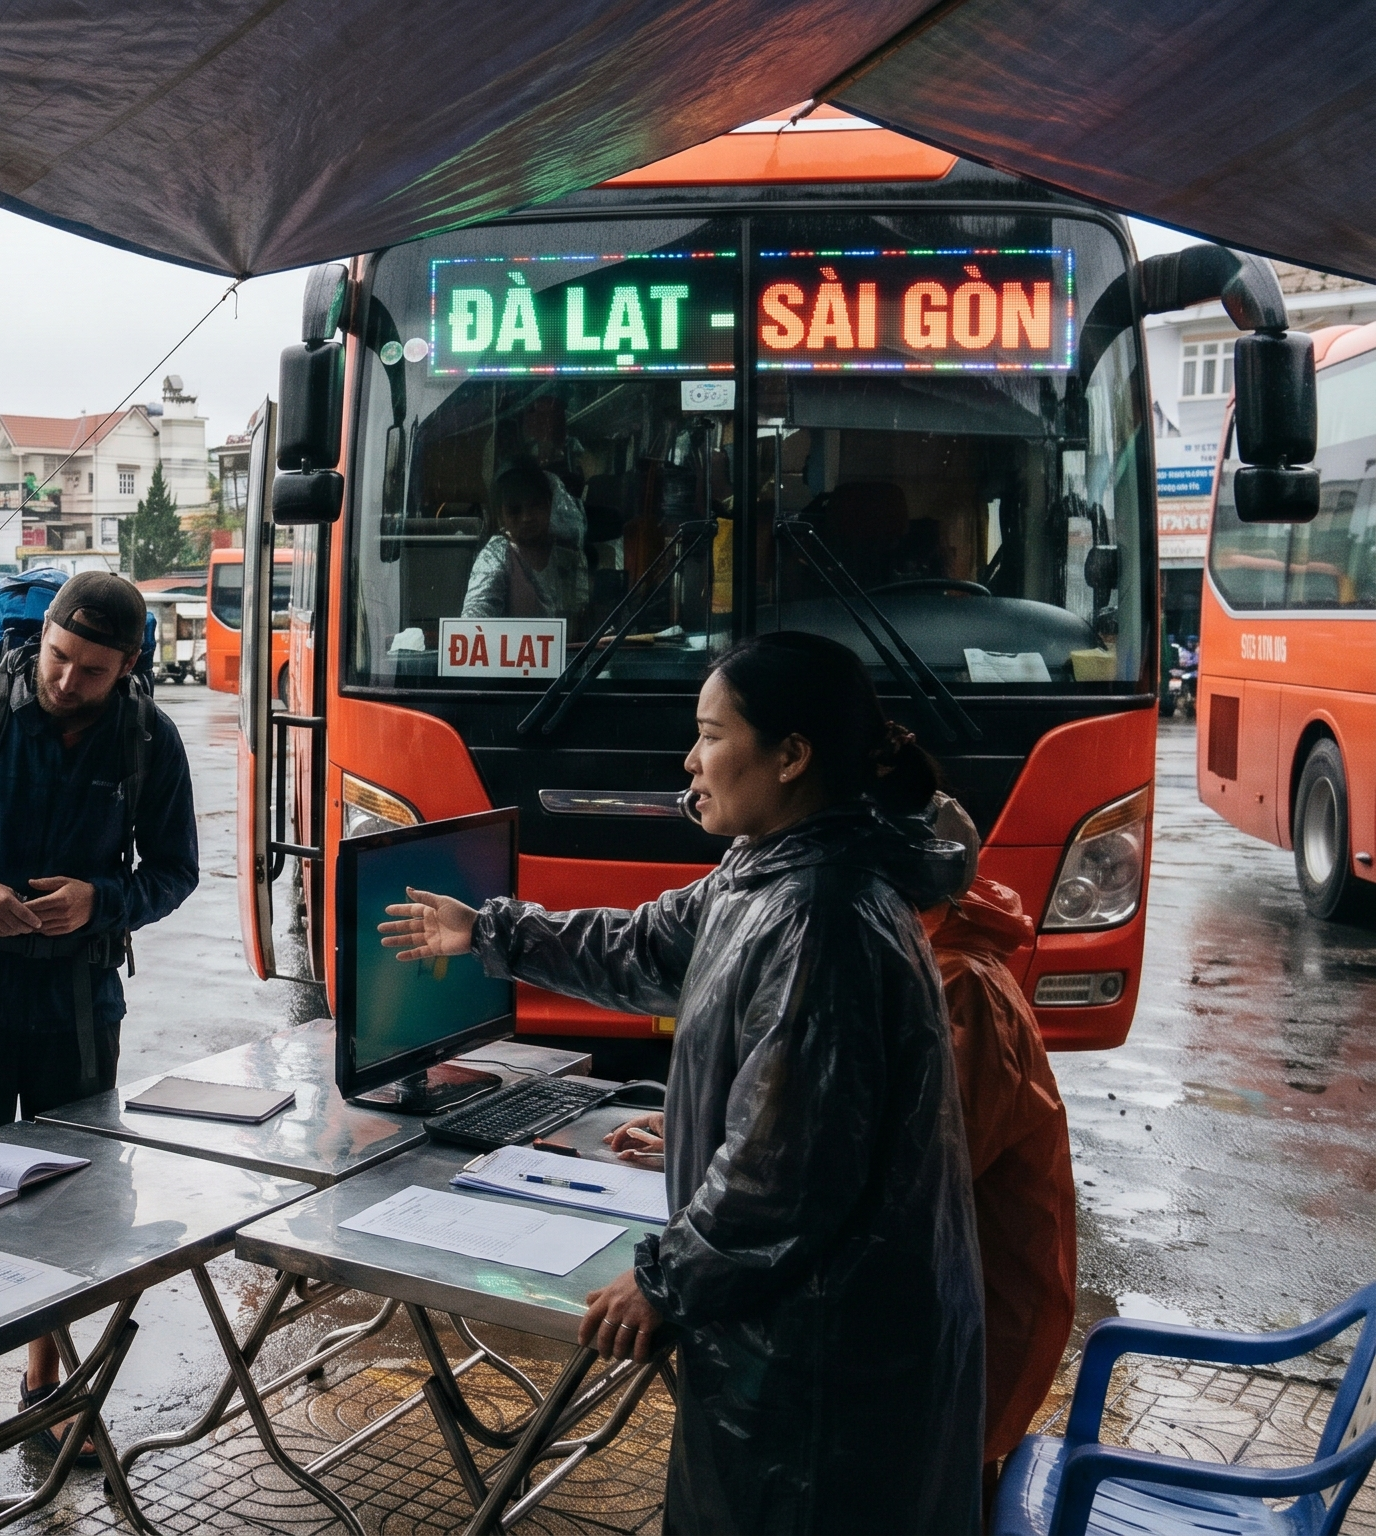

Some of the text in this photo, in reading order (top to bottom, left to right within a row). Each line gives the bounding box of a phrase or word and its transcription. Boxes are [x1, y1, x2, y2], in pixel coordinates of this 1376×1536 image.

[448, 271, 543, 352] ĐÀ
[566, 284, 689, 366] LẠT
[760, 266, 878, 349] SÀI
[903, 264, 1052, 349] GÒN
[448, 625, 555, 676] ĐÀ LẠT
